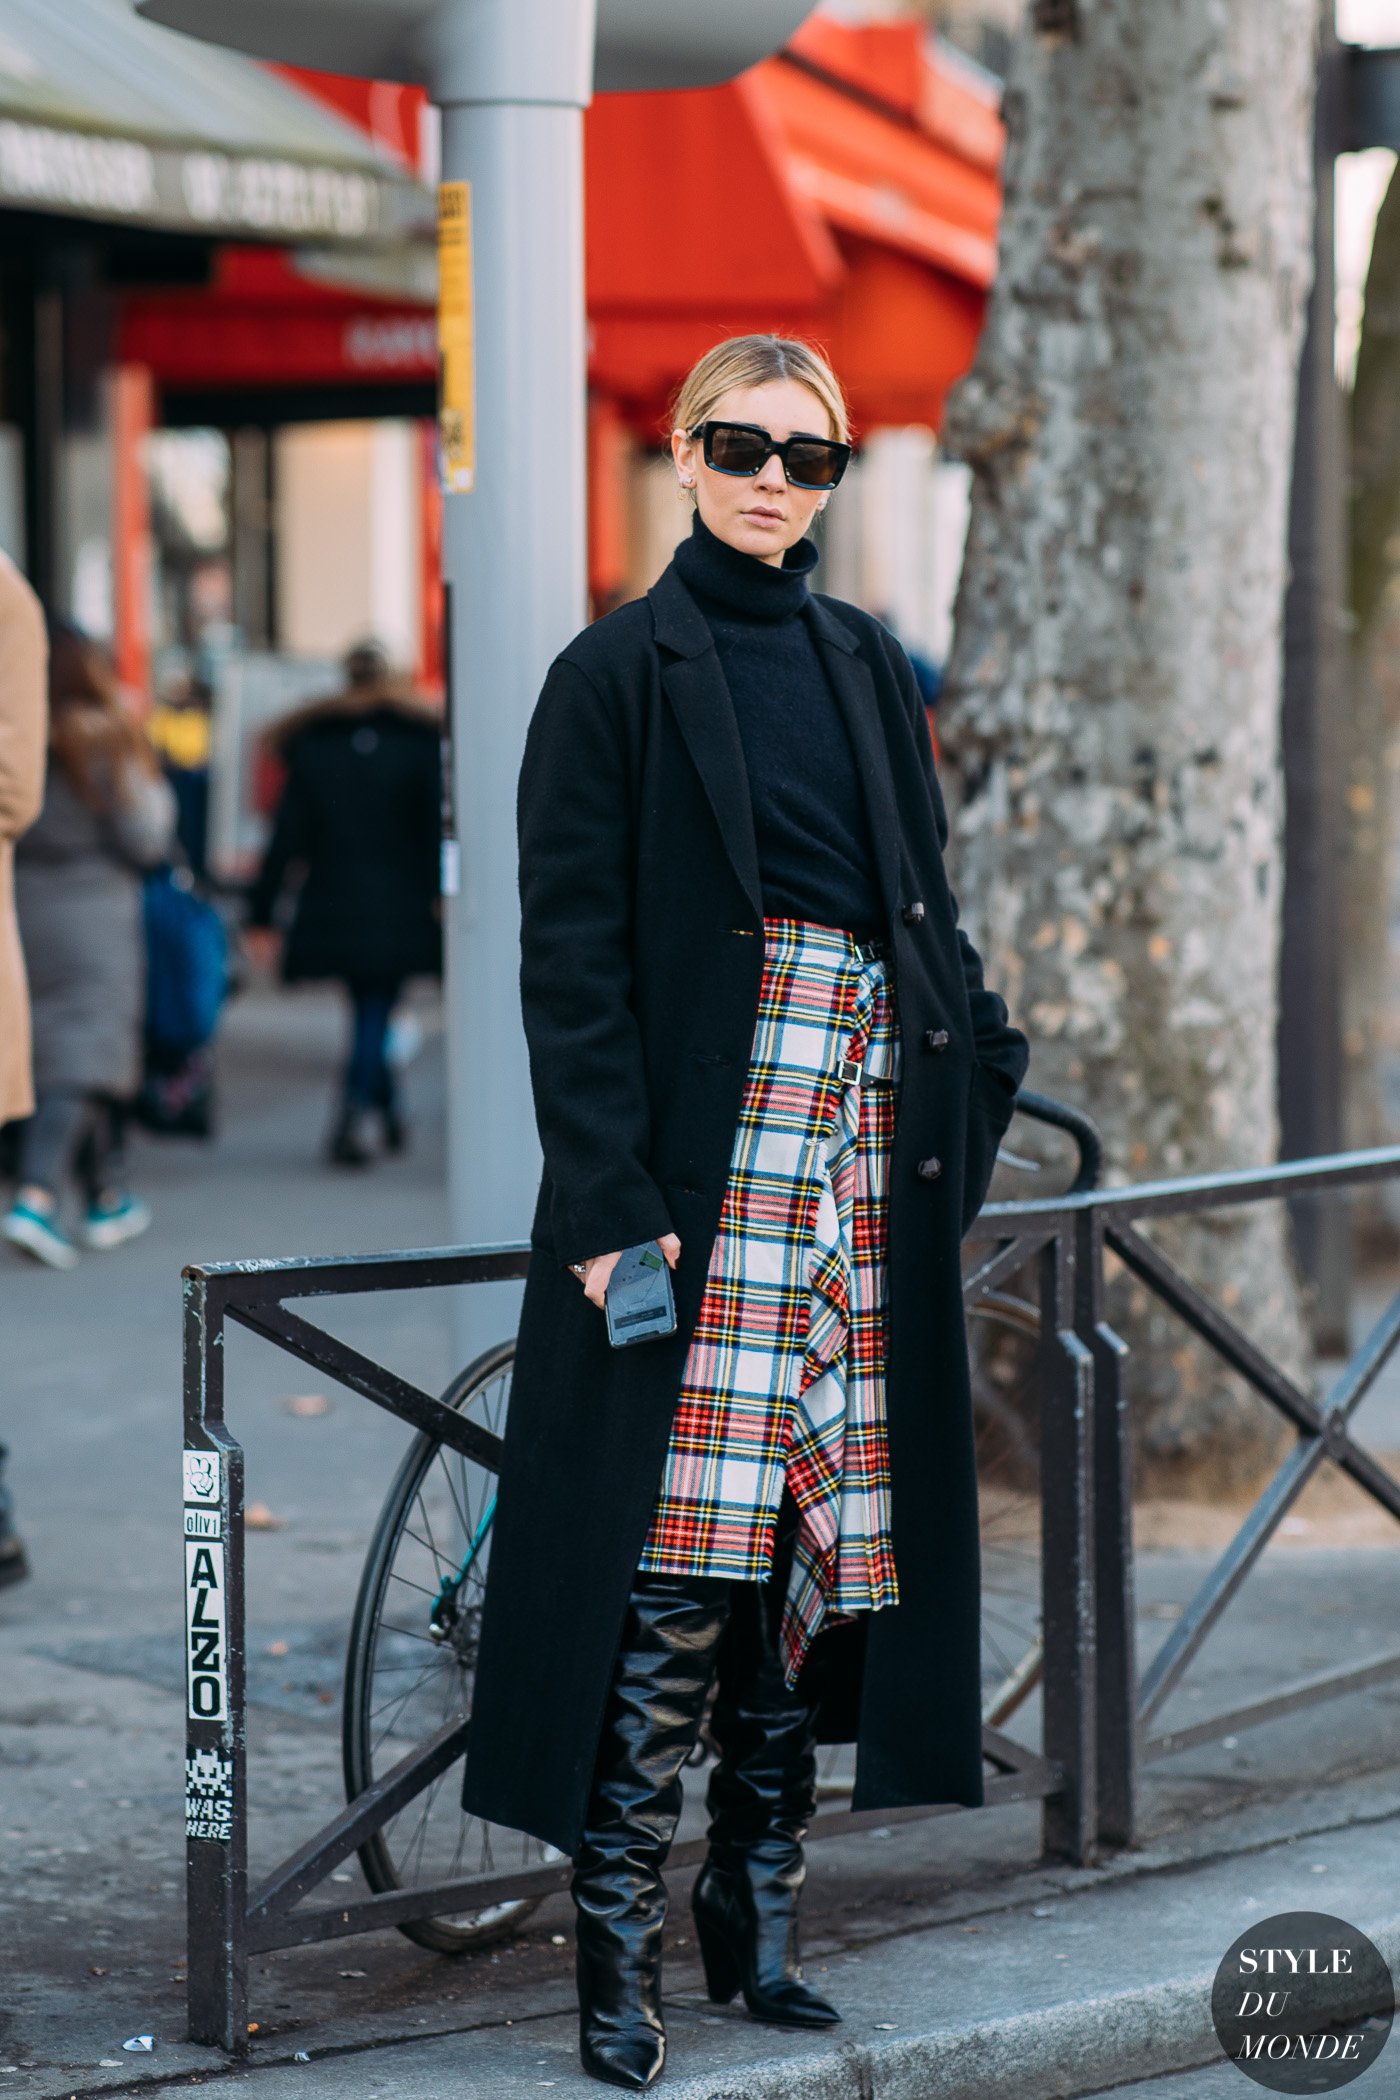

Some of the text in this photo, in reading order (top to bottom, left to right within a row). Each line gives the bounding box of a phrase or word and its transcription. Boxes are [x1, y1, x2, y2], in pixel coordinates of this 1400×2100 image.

[190, 1548, 221, 1717] ALZO
[185, 1798, 233, 1821] WAS
[185, 1820, 233, 1839] HERE
